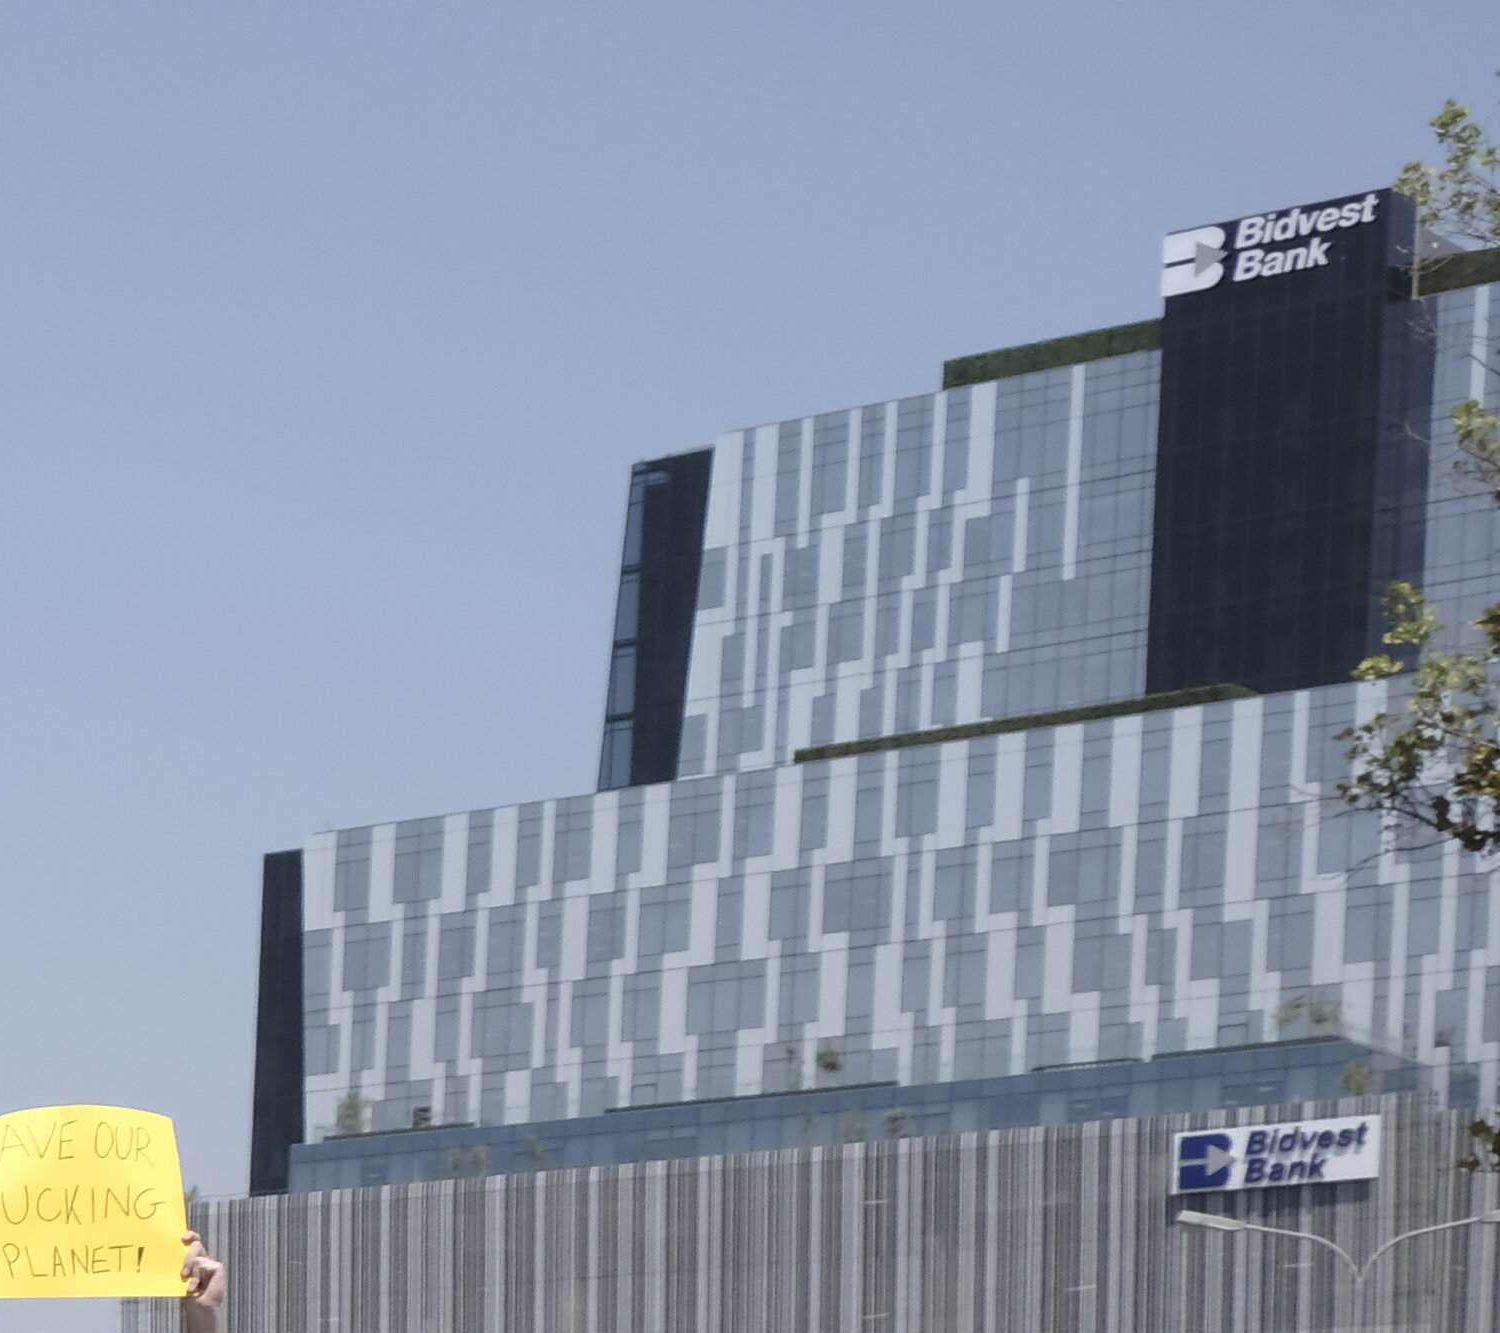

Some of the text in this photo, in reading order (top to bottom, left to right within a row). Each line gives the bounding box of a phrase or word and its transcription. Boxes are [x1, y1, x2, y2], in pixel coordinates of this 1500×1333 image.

[1233, 193, 1380, 249] Bidvest
[1232, 237, 1333, 283] Bank
[94, 1120, 155, 1168] OUR
[1245, 1121, 1369, 1155] Bidvest
[1244, 1151, 1329, 1184] Bank
[2, 1243, 145, 1279] PLANET!
